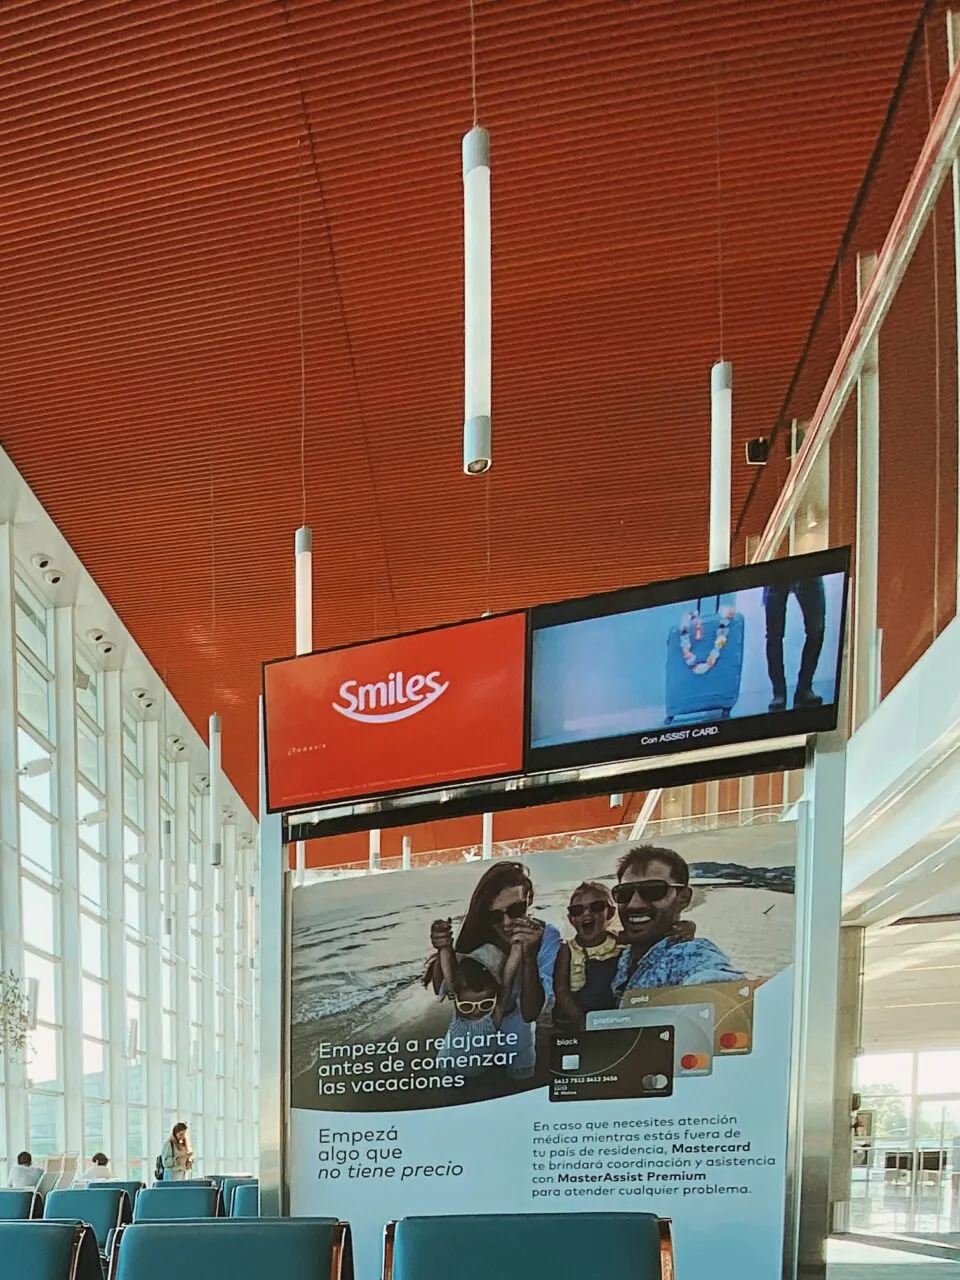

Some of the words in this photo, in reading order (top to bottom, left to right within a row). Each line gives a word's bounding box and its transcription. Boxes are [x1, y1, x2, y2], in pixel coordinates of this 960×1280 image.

[334, 671, 448, 721] Smiles
[641, 737, 658, 745] Con
[659, 730, 690, 742] ASSIST
[630, 995, 649, 1004] gold
[592, 1016, 631, 1025] platinum
[318, 1036, 399, 1060] Empezá
[406, 1040, 418, 1052] a
[425, 1031, 518, 1051] relajarte
[318, 1062, 374, 1077] antes
[380, 1056, 404, 1073] de
[410, 1051, 518, 1071] comenzar
[318, 1079, 346, 1095] las
[351, 1074, 464, 1094] vacaciones
[534, 1121, 549, 1132] En
[553, 1122, 582, 1131] caso
[586, 1121, 609, 1131] que
[613, 1117, 674, 1128] necesites
[678, 1114, 737, 1126] atención
[319, 1125, 398, 1146] Empezá
[533, 1133, 578, 1144] médica
[582, 1132, 640, 1143] mientras
[644, 1130, 680, 1141] estás
[684, 1129, 720, 1140] fuera
[724, 1128, 740, 1138] de
[318, 1146, 360, 1164] algo
[366, 1147, 402, 1163] que
[533, 1149, 546, 1158] tu
[550, 1147, 576, 1158] país
[579, 1146, 594, 1156] de
[598, 1145, 668, 1156] residencia,
[672, 1142, 750, 1154] Mastercard
[318, 1168, 340, 1179] no
[348, 1163, 396, 1178] tiene
[400, 1160, 464, 1181] precio
[532, 1162, 545, 1171] te
[549, 1159, 603, 1170] brindará
[607, 1158, 691, 1169] coordinación
[695, 1160, 702, 1169] y
[706, 1156, 776, 1166] asistencia
[532, 1176, 554, 1184] con
[558, 1172, 644, 1183] MasterAssist
[647, 1171, 706, 1181] Premium
[532, 1188, 560, 1198] para
[564, 1186, 615, 1196] atender
[618, 1185, 679, 1197] cualquier
[683, 1184, 752, 1197] problema.
